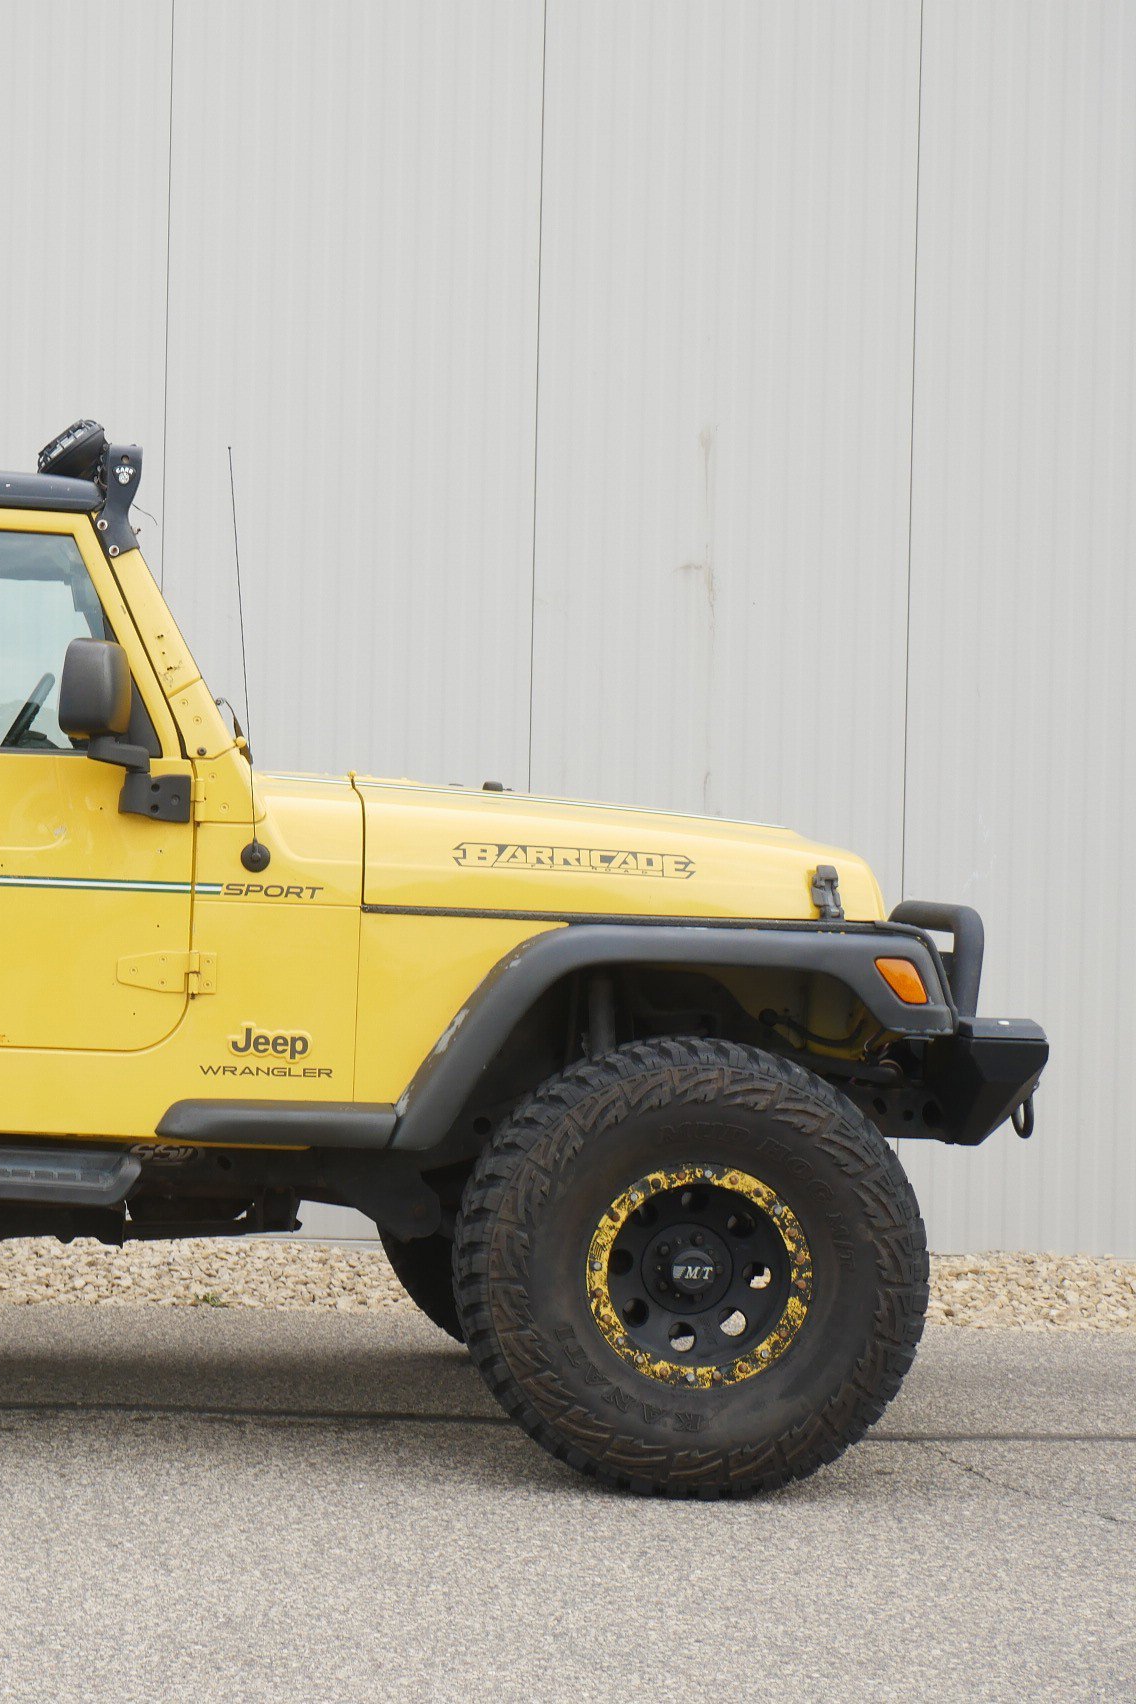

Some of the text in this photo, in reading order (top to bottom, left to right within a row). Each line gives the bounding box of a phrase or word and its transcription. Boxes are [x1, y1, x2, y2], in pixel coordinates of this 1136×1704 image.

[453, 842, 696, 879] BARRICADE
[223, 883, 324, 899] SPORT
[231, 1027, 309, 1060] Jeep
[199, 1065, 333, 1078] WRANGLER
